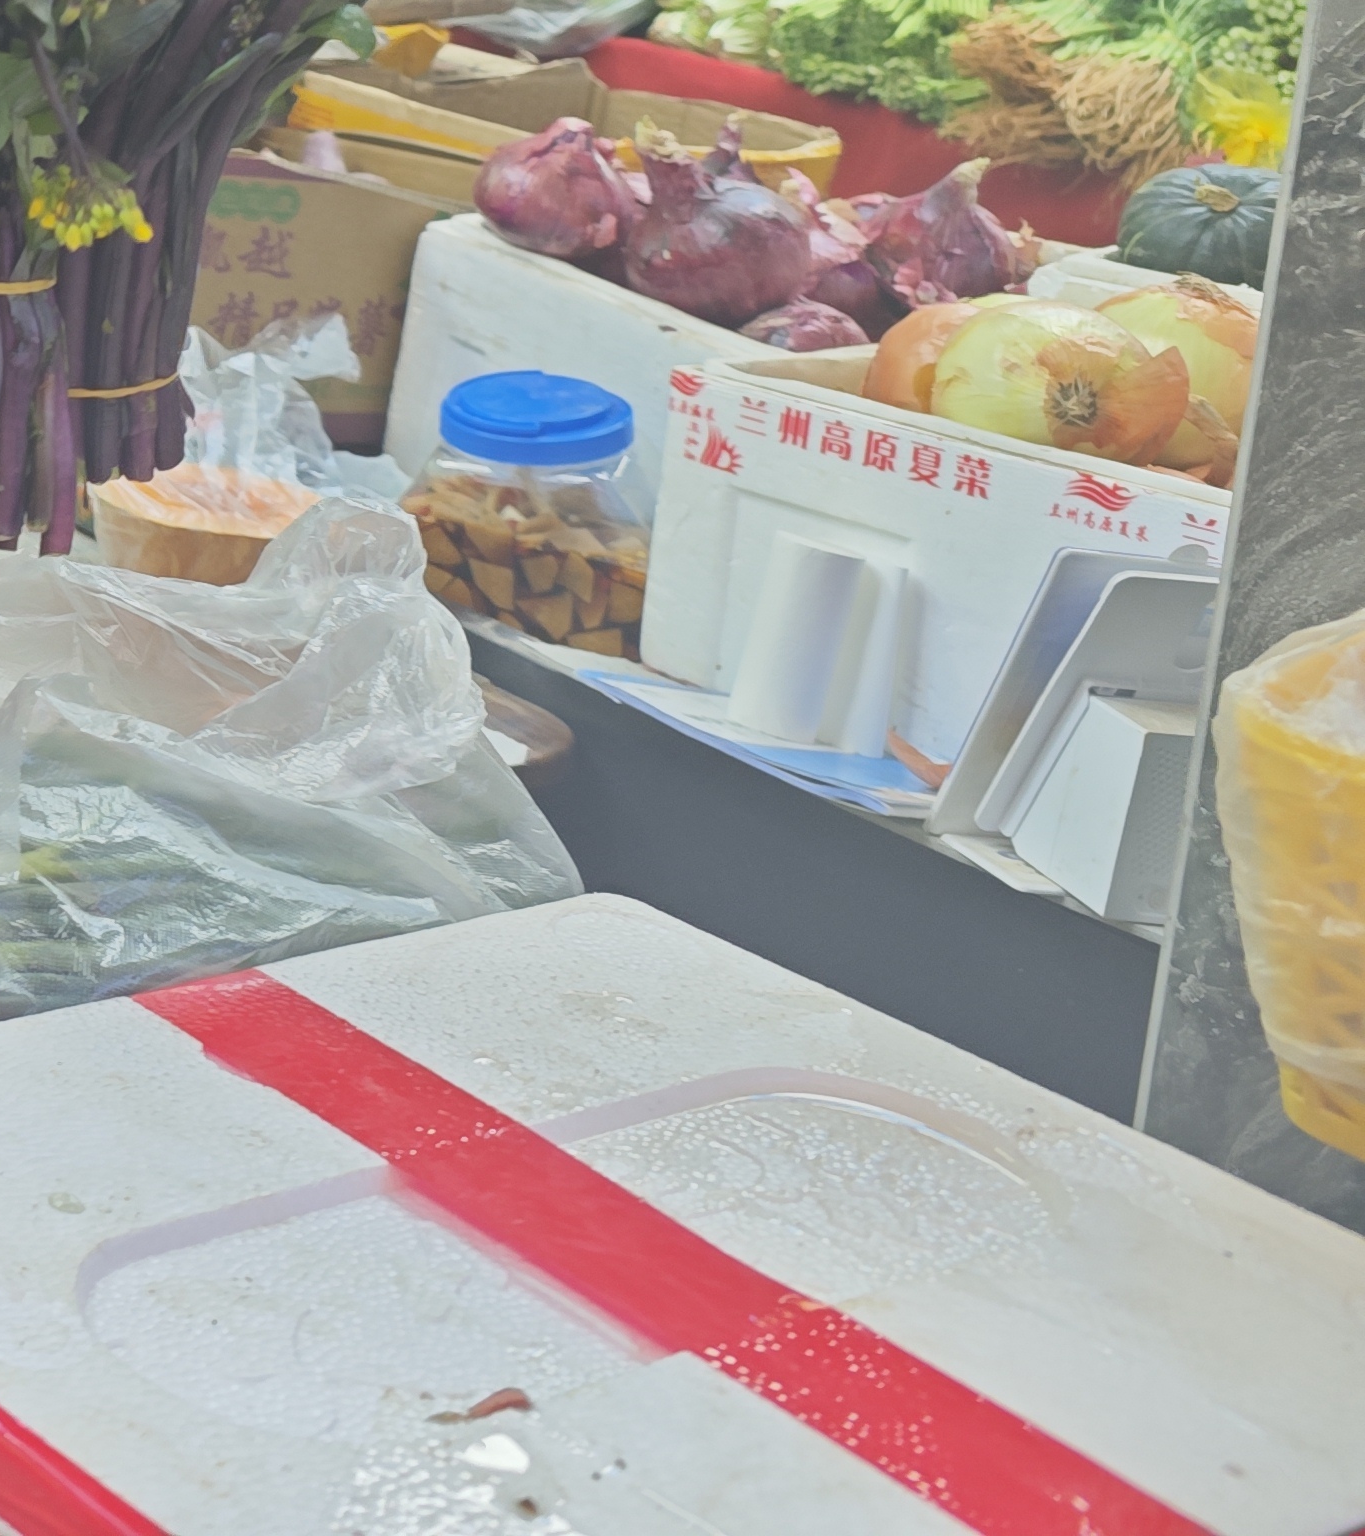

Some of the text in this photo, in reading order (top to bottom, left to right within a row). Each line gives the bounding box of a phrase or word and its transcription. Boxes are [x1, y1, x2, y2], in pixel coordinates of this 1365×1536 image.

[735, 394, 994, 500] 兰州高原夏菜
[1048, 501, 1150, 543] 兰州高原夏菜
